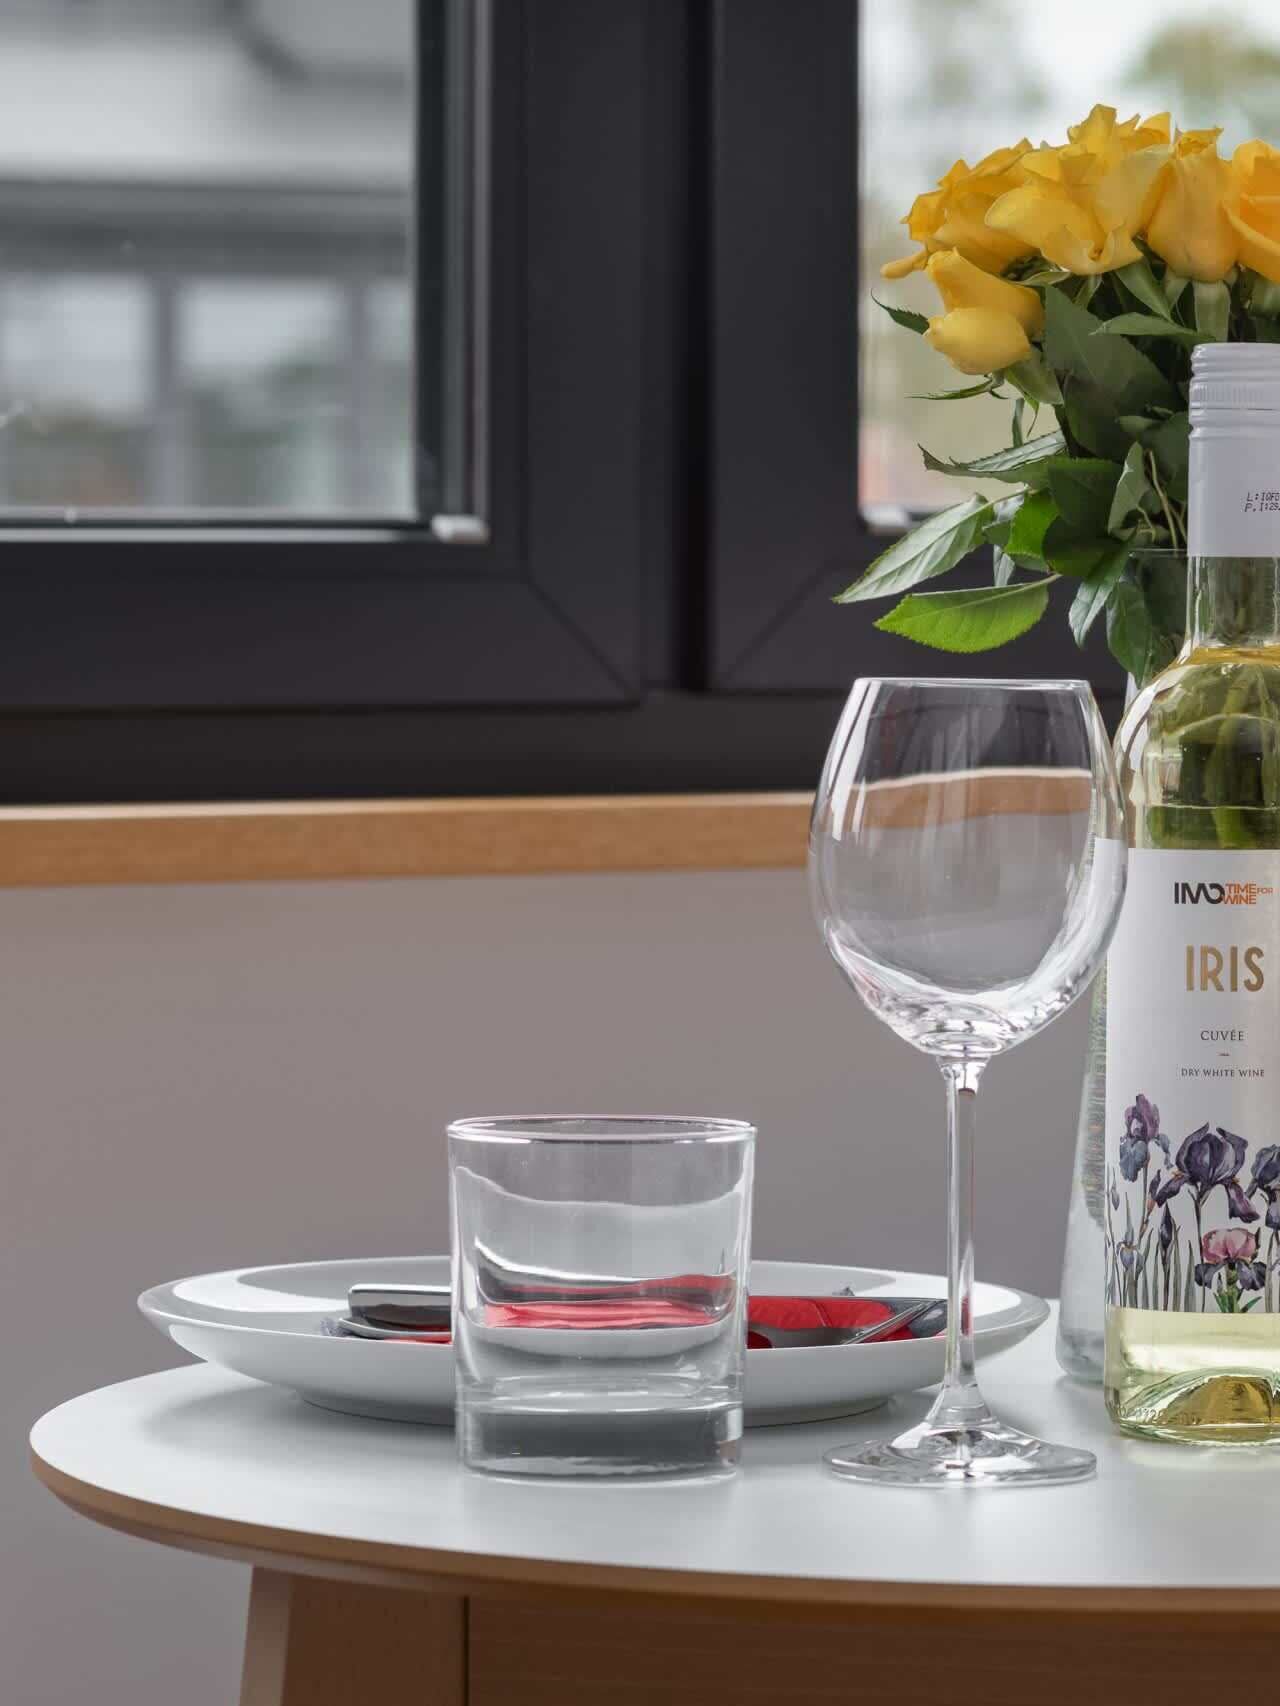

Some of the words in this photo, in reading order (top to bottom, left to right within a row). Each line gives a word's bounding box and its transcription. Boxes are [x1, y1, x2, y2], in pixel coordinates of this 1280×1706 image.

[1174, 882, 1225, 904] IMO
[1225, 883, 1256, 894] TIME
[1223, 894, 1256, 904] WINE
[1186, 945, 1265, 993] IRIS
[1200, 1029, 1245, 1041] CUVÉE
[1181, 1068, 1200, 1078] DRY
[1203, 1068, 1235, 1078] WHITE
[1238, 1068, 1265, 1078] WINE
